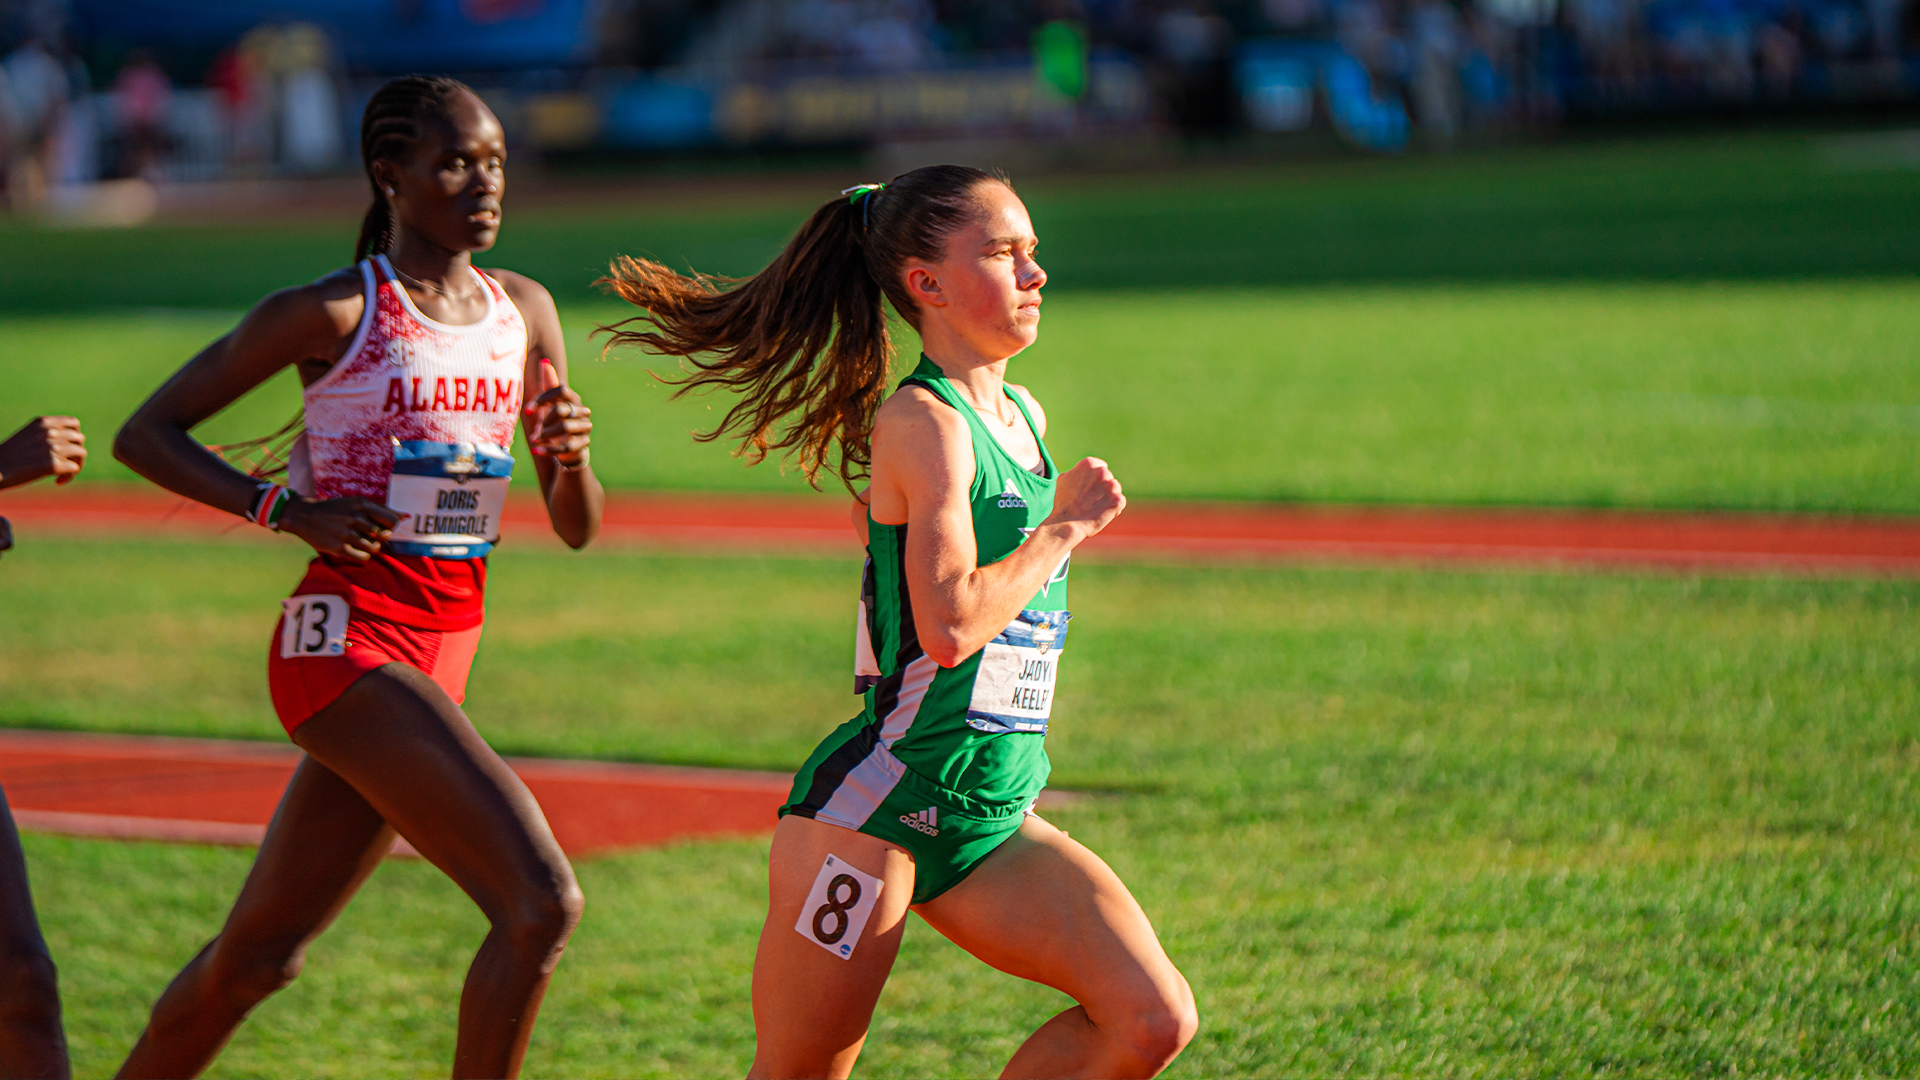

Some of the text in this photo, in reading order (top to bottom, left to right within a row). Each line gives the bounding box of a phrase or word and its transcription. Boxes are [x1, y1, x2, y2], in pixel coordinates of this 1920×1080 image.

[436, 489, 481, 511] DORIS
[414, 513, 489, 535] LEMNGOLE
[294, 602, 330, 653] 13
[1011, 687, 1049, 711] KEELE
[899, 814, 939, 837] adidas
[812, 873, 862, 945] 8
